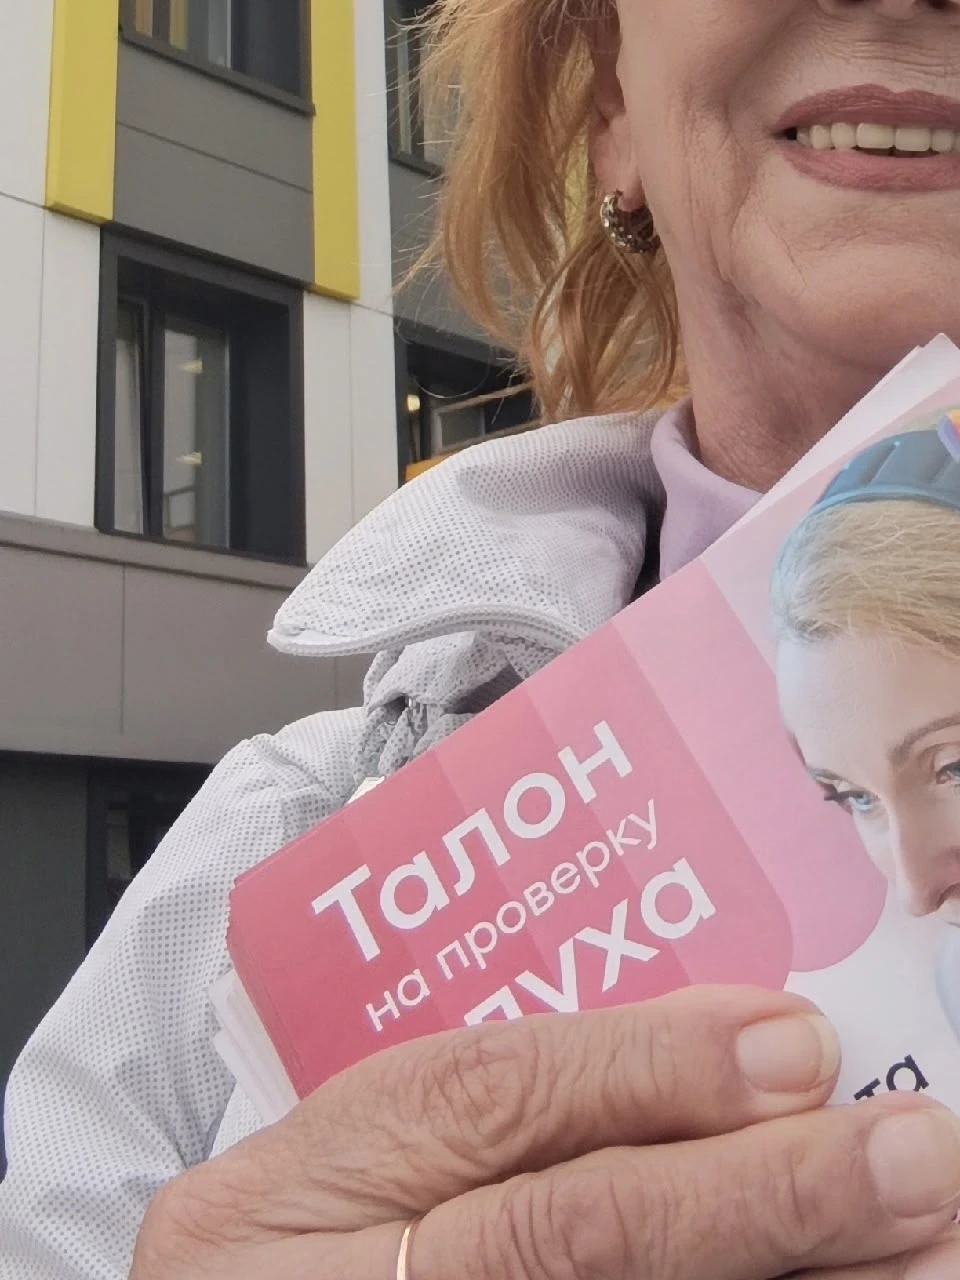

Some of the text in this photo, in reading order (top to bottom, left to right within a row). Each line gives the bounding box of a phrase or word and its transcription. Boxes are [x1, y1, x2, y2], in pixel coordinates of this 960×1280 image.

[312, 720, 632, 961] Талон
[366, 799, 658, 1031] на проверку
